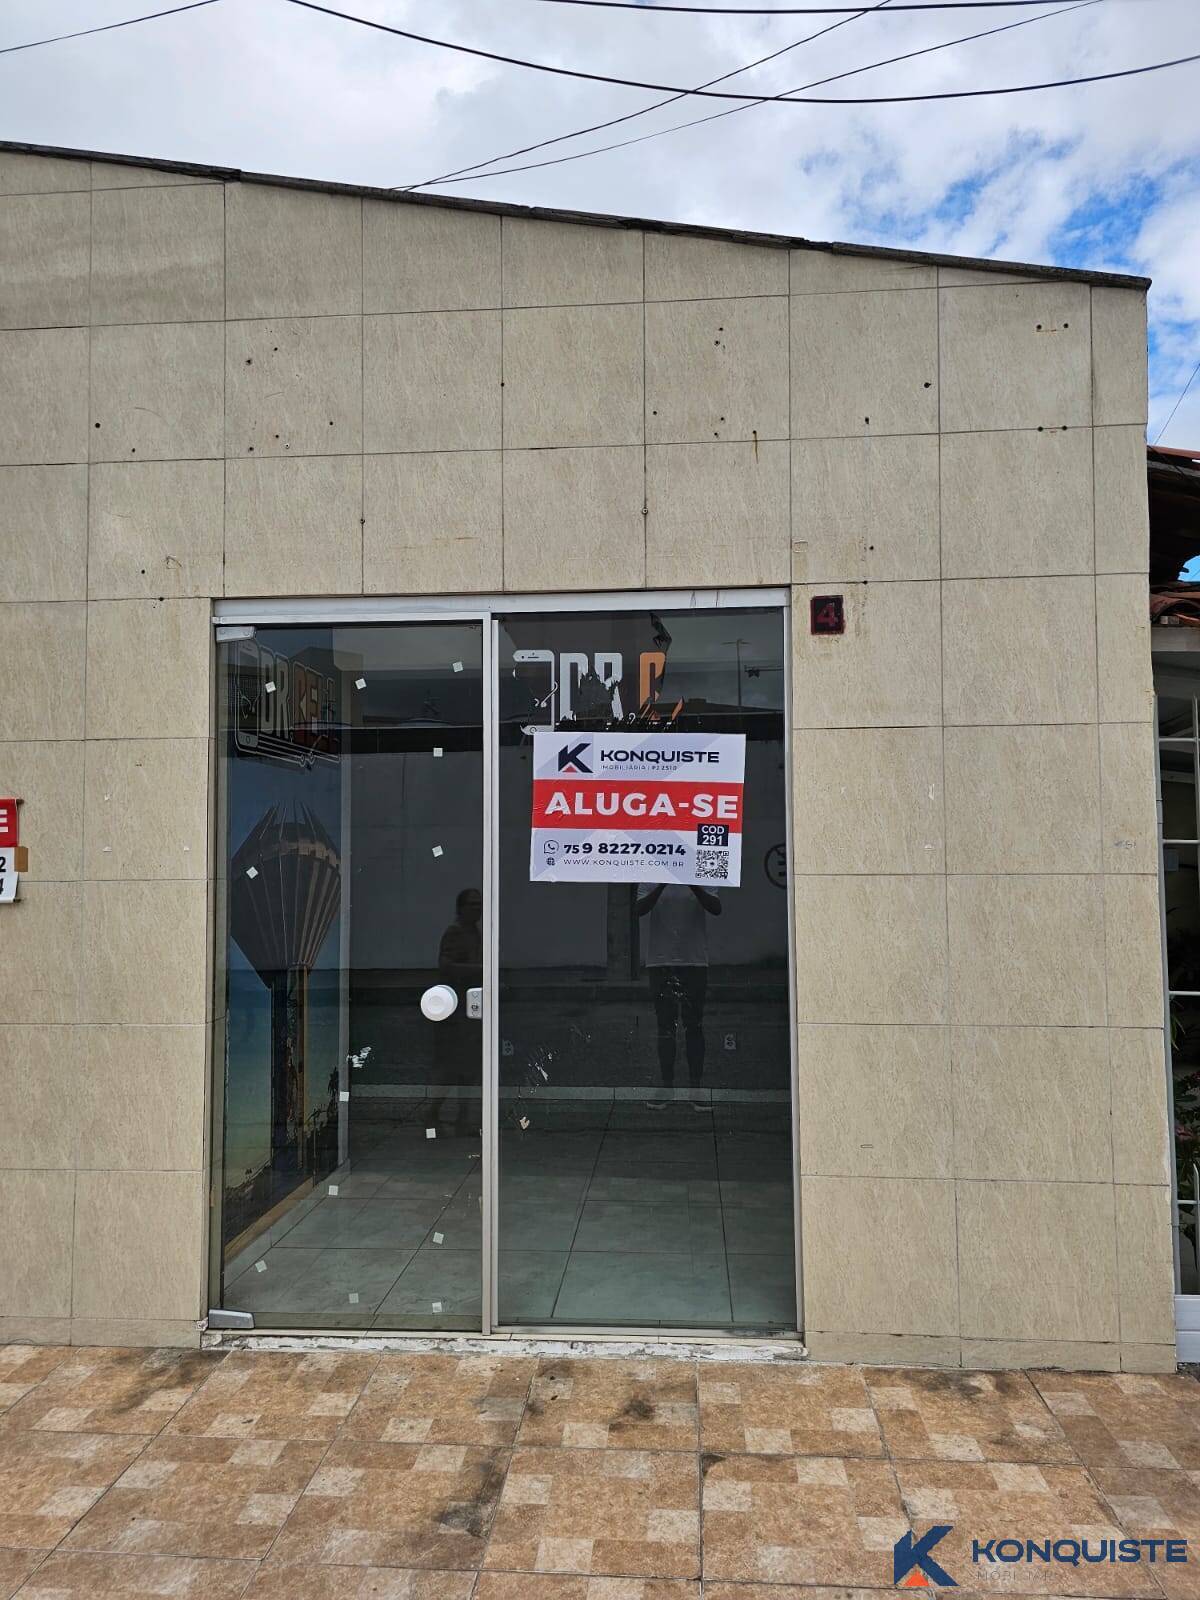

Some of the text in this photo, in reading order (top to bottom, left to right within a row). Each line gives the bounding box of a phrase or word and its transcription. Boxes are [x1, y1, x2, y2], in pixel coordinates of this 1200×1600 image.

[600, 749, 720, 764] KONQUISTE
[544, 791, 739, 819] ALUGA-SE
[701, 825, 725, 835] COD
[702, 834, 723, 846] 291
[598, 842, 686, 856] 8227.0214
